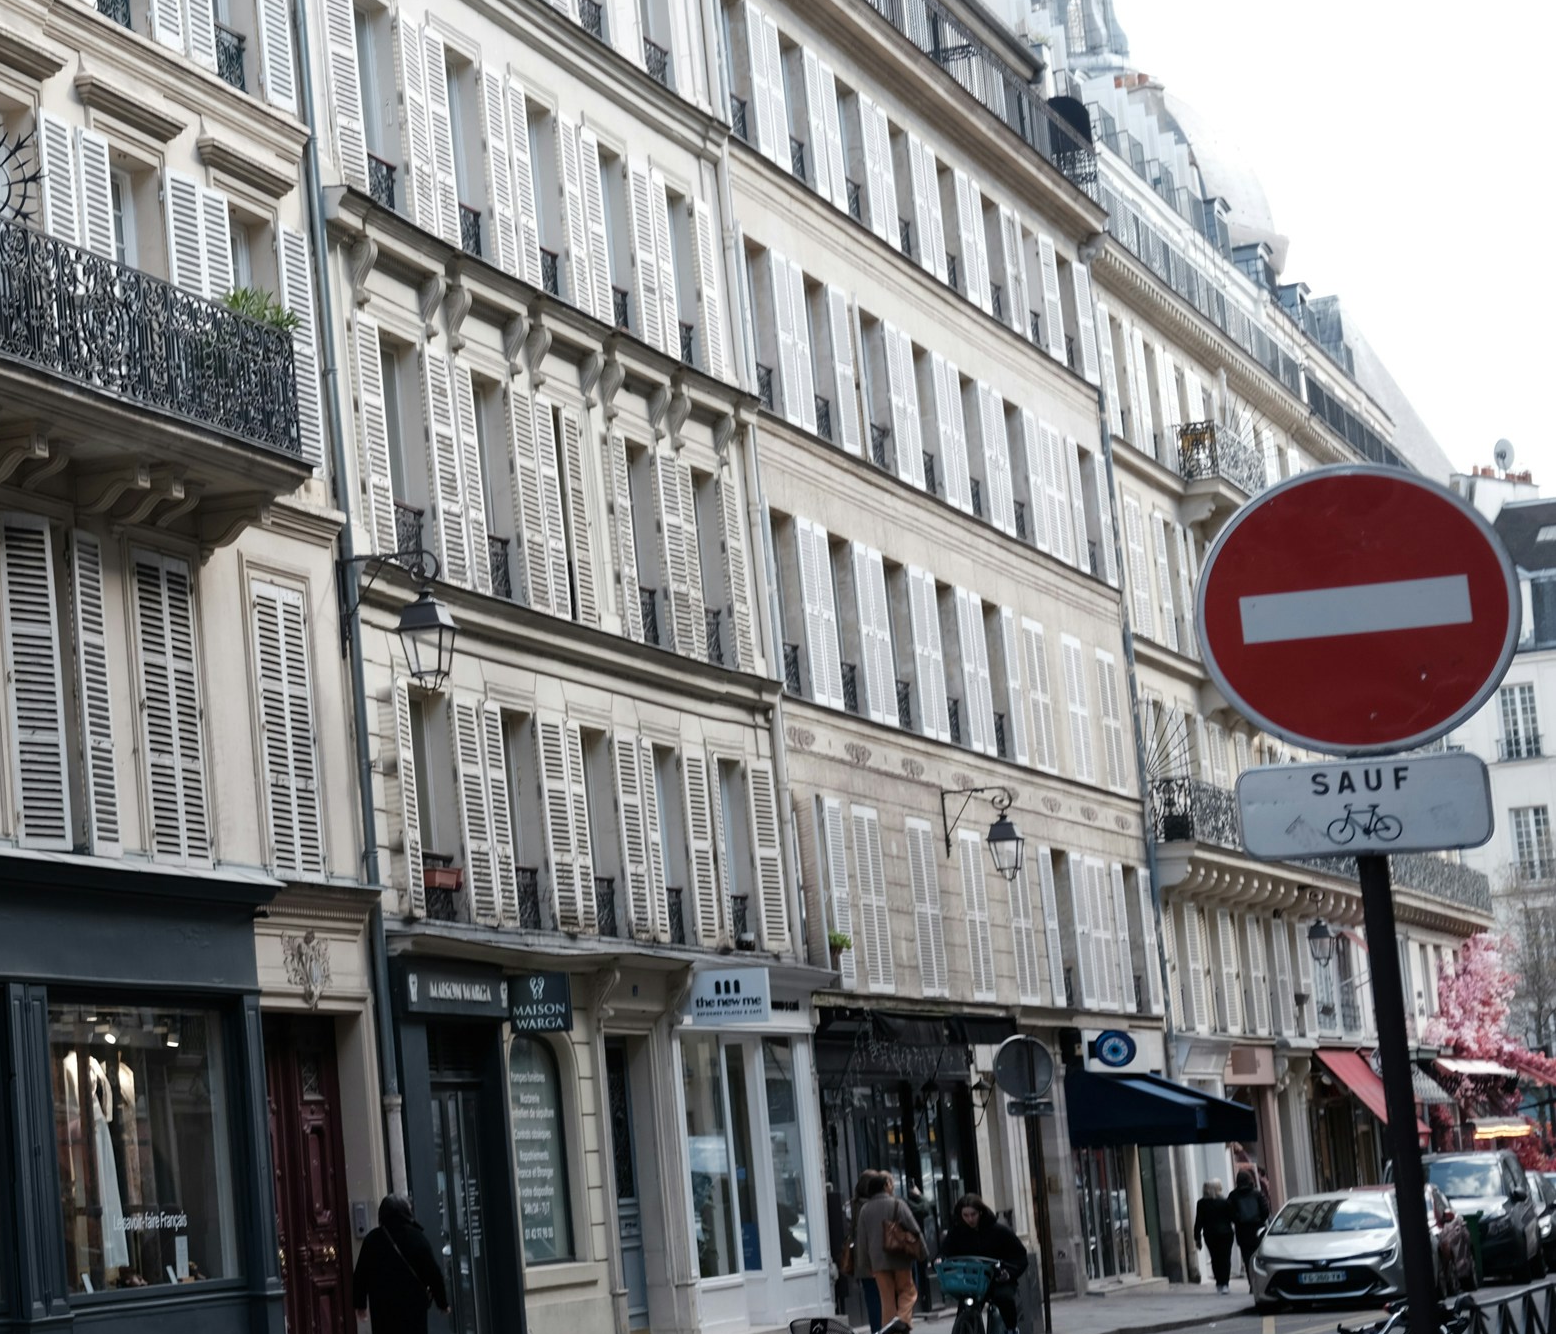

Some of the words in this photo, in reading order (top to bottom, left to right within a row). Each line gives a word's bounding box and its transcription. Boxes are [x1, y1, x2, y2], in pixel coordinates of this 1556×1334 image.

[1310, 766, 1410, 797] SAUF
[429, 980, 462, 1000] MAISON
[462, 982, 492, 1002] WARGA
[512, 1002, 566, 1017] MAISON
[695, 996, 715, 1008] the
[717, 997, 741, 1008] new
[742, 996, 762, 1006] me
[516, 1017, 564, 1030] WARGA
[113, 1214, 122, 1231] Le
[122, 1211, 159, 1230] savoir-faire
[160, 1209, 188, 1232] Français
